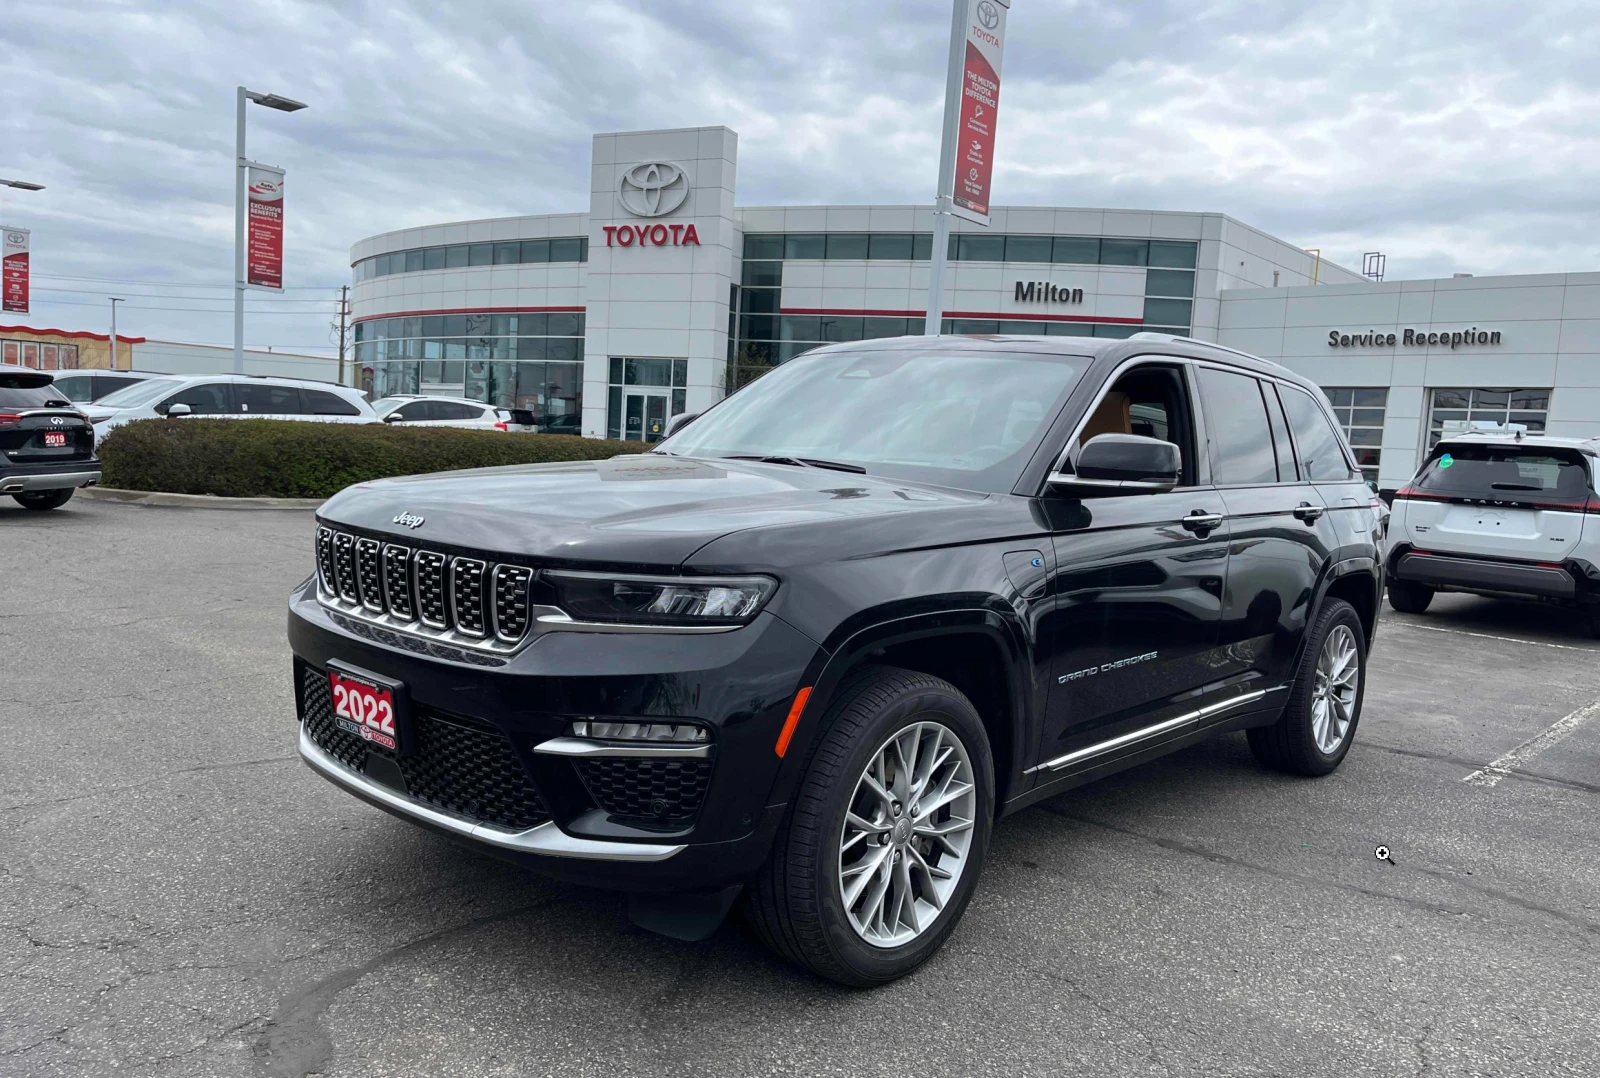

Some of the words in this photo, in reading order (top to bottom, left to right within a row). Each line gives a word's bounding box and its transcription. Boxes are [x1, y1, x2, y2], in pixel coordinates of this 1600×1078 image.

[972, 25, 999, 48] TOYOTA
[967, 70, 978, 81] THE
[978, 75, 997, 91] MILTON
[972, 82, 991, 97] TOYOTA
[965, 88, 996, 108] DIFFERENCE
[250, 202, 281, 213] EXCLUSIVE
[250, 208, 278, 218] BENEFITS
[602, 224, 700, 246] TOYOTA
[1015, 281, 1083, 302] Milton
[1328, 330, 1396, 347] Service
[1402, 327, 1502, 350] Reception
[45, 434, 65, 444] 2019
[392, 511, 425, 530] Jeep
[1058, 666, 1098, 684] GRAND
[1101, 651, 1158, 672] CHEROKEE
[334, 684, 396, 737] 2022
[340, 719, 359, 733] MILTON
[372, 732, 394, 746] TOYOTA
